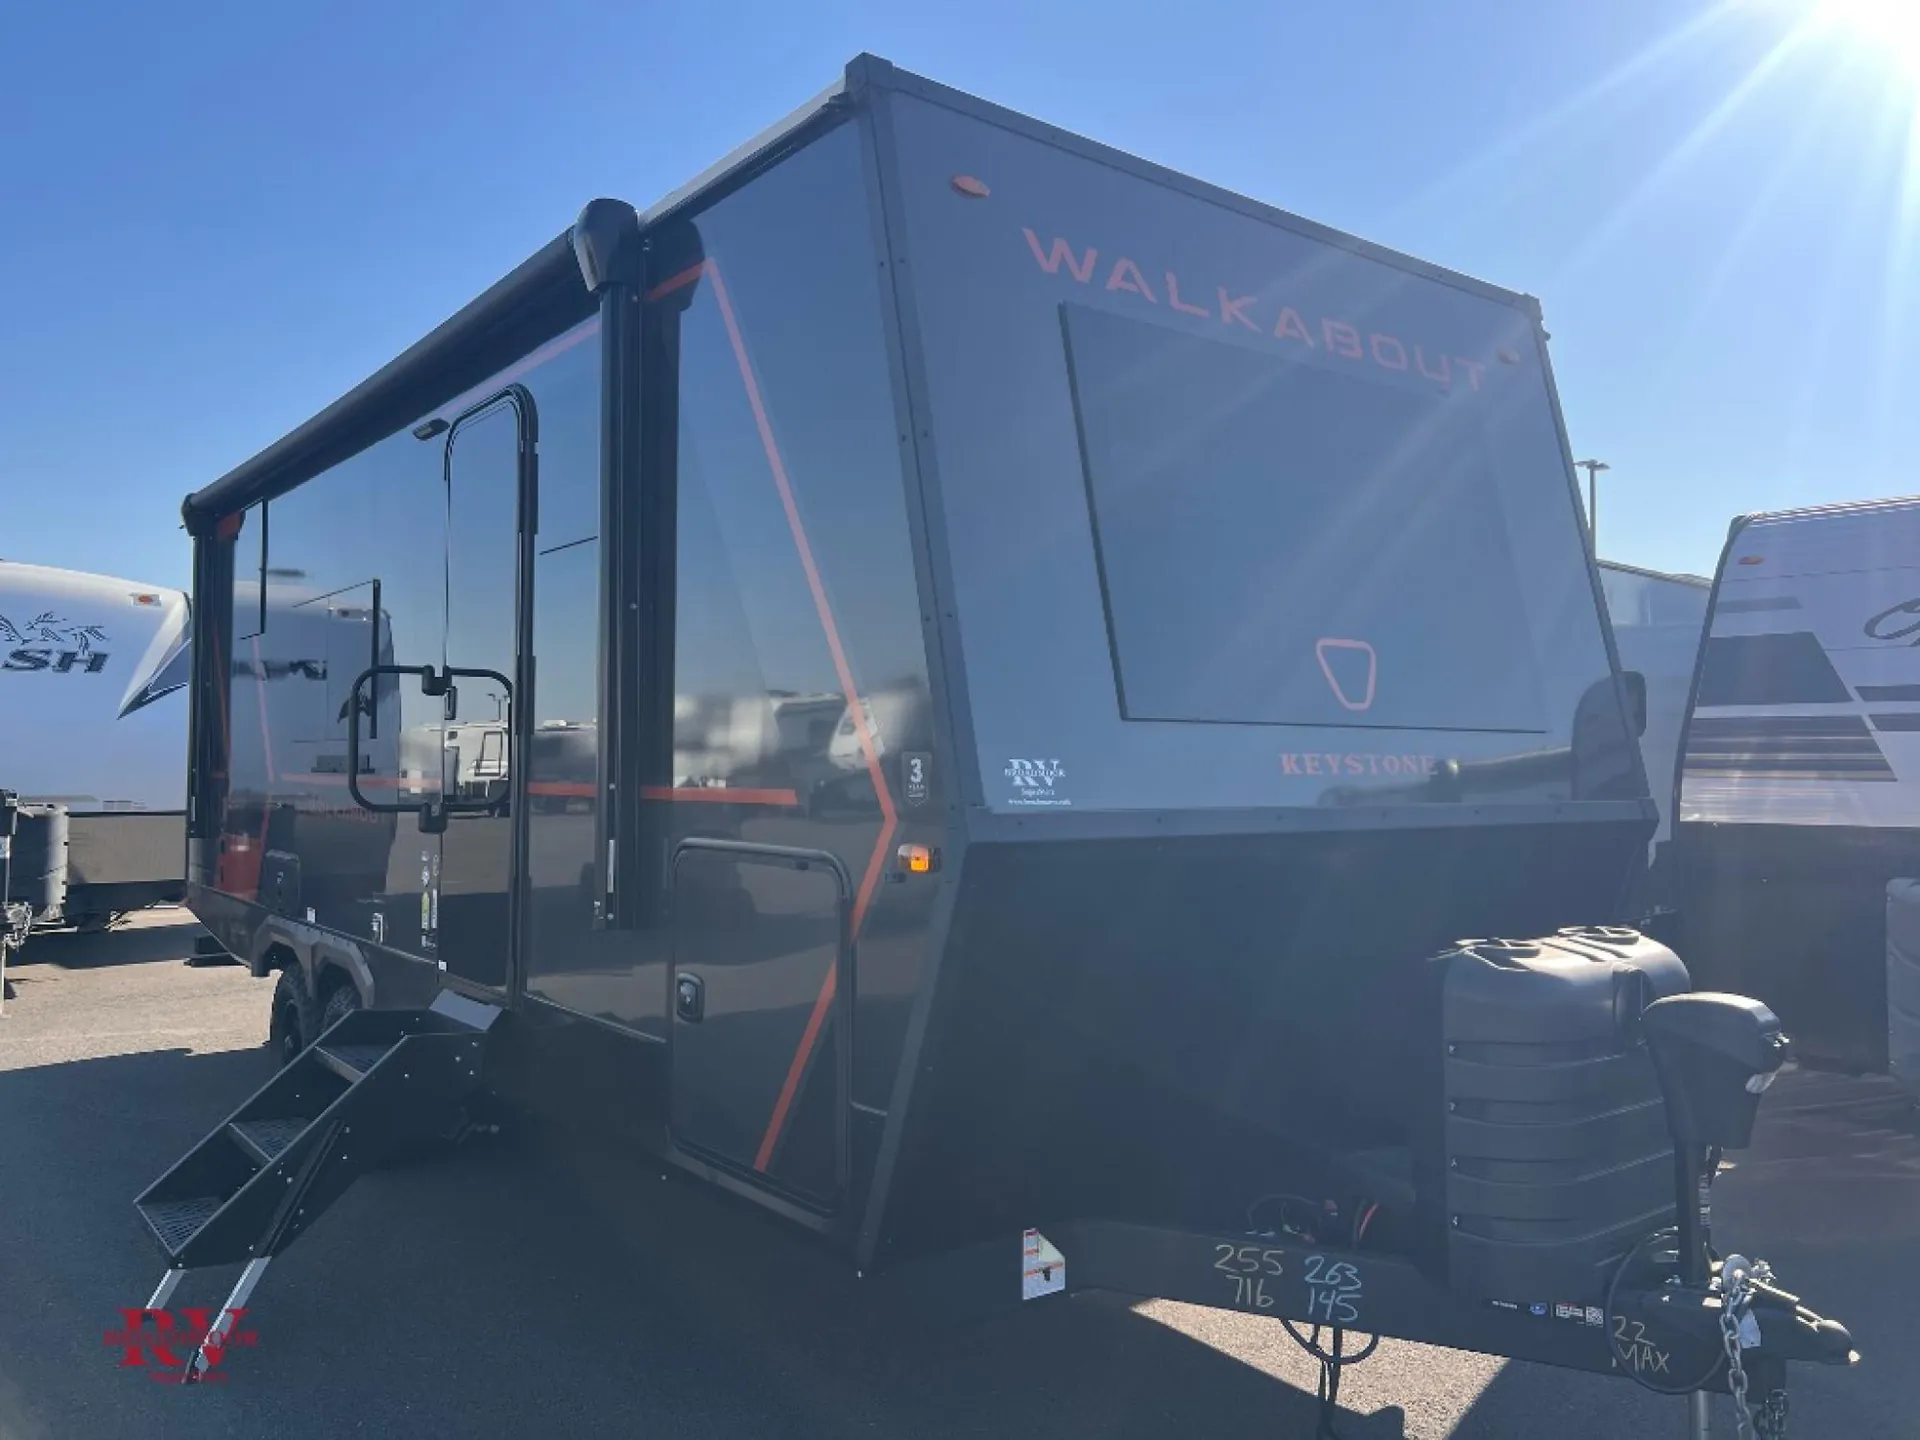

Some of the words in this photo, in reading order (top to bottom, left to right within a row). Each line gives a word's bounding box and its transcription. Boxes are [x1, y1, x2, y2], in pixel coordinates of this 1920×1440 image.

[1022, 227, 1487, 392] WALKABOUT
[910, 758, 923, 783] 3
[1280, 752, 1438, 776] KEYSTONE
[1214, 1244, 1285, 1275] 255
[1304, 1255, 1363, 1290] 263
[1225, 1274, 1275, 1308] 716
[1308, 1286, 1363, 1321] 145
[1612, 1316, 1656, 1347] 22
[1612, 1343, 1670, 1374] MAX
